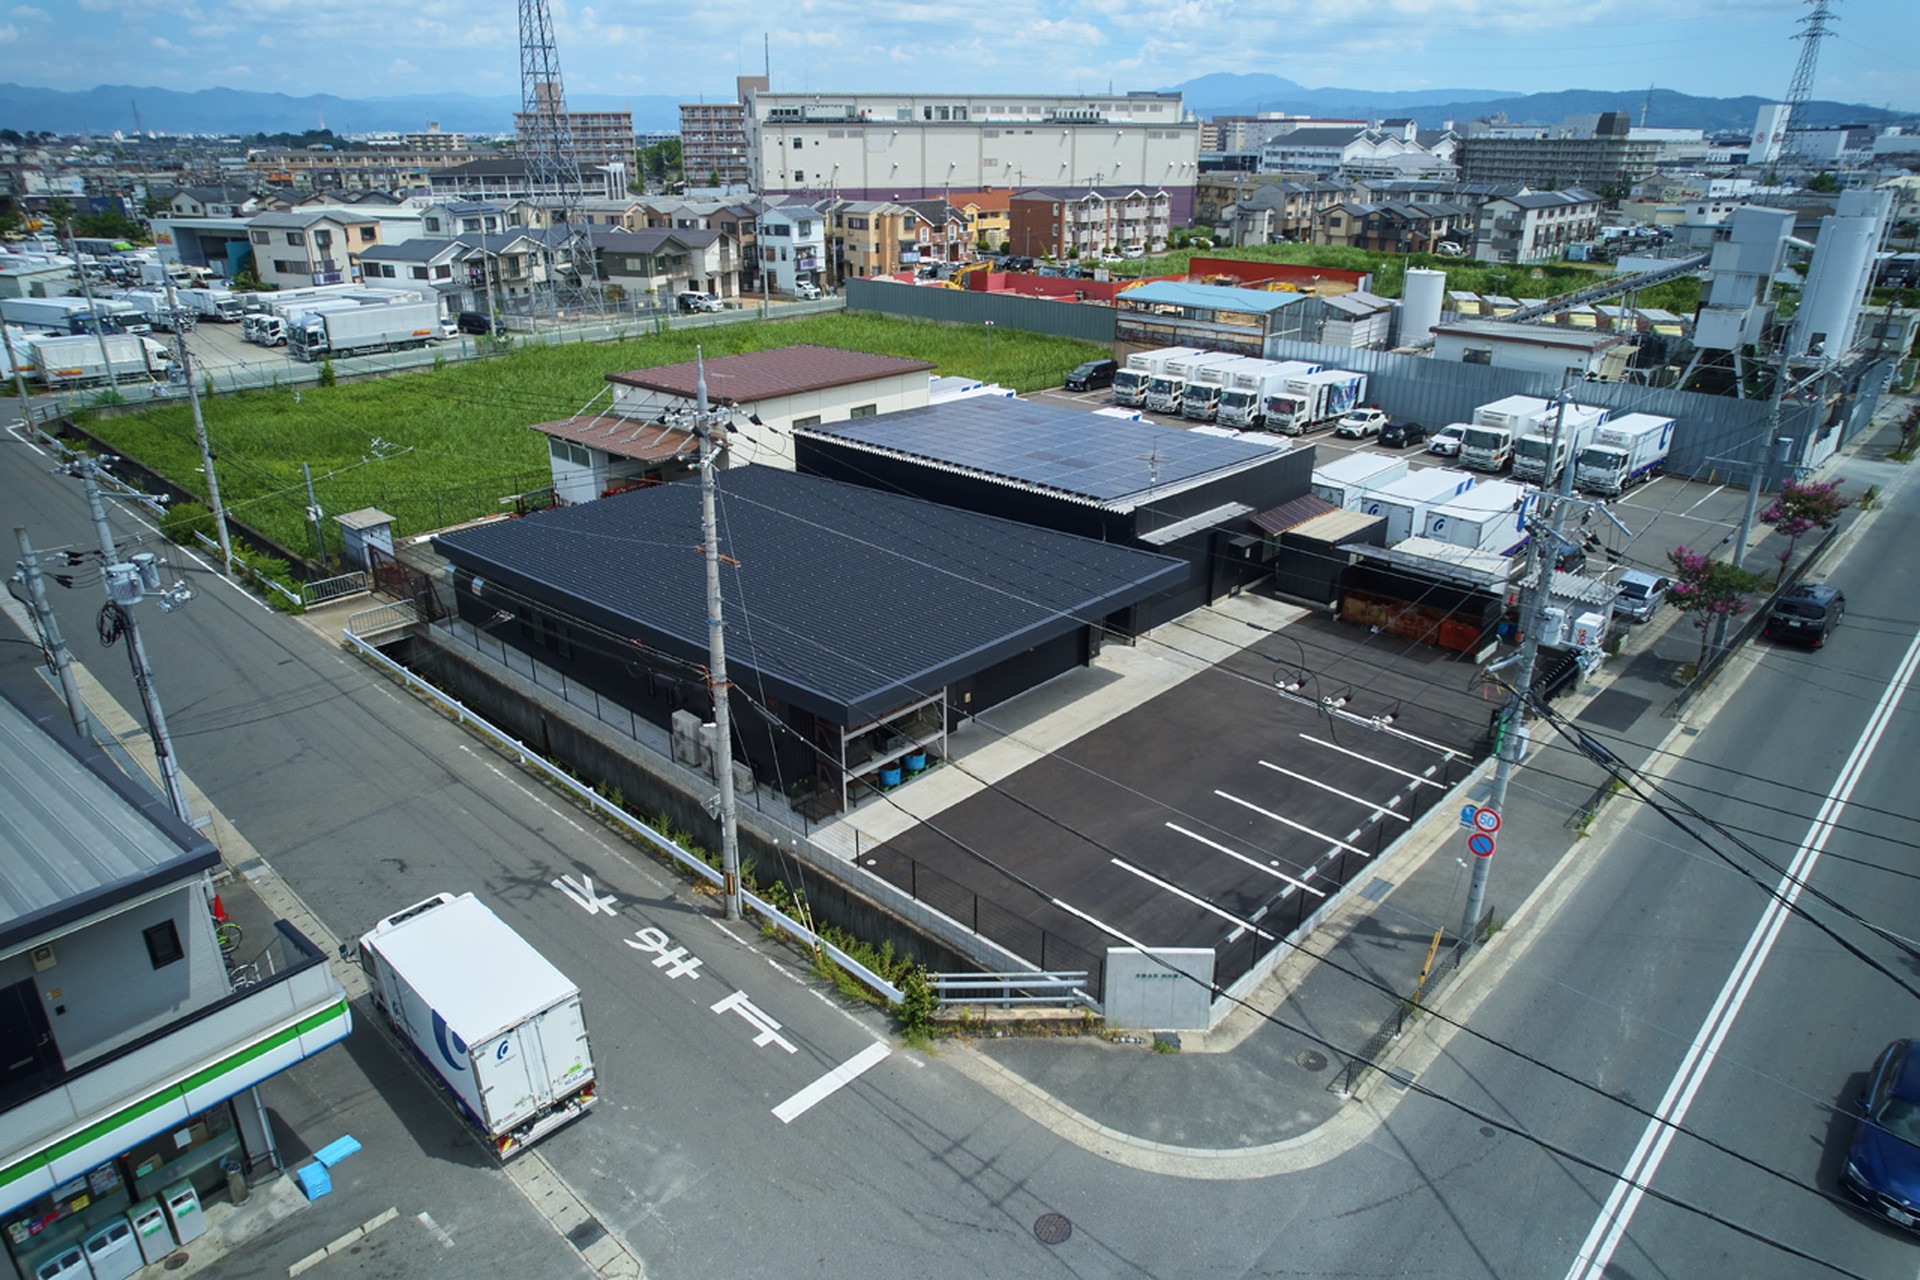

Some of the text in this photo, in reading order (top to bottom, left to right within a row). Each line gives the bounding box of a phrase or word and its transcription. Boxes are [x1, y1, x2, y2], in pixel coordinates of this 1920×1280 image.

[1480, 812, 1495, 828] 50
[551, 874, 799, 1054] 止まれ
